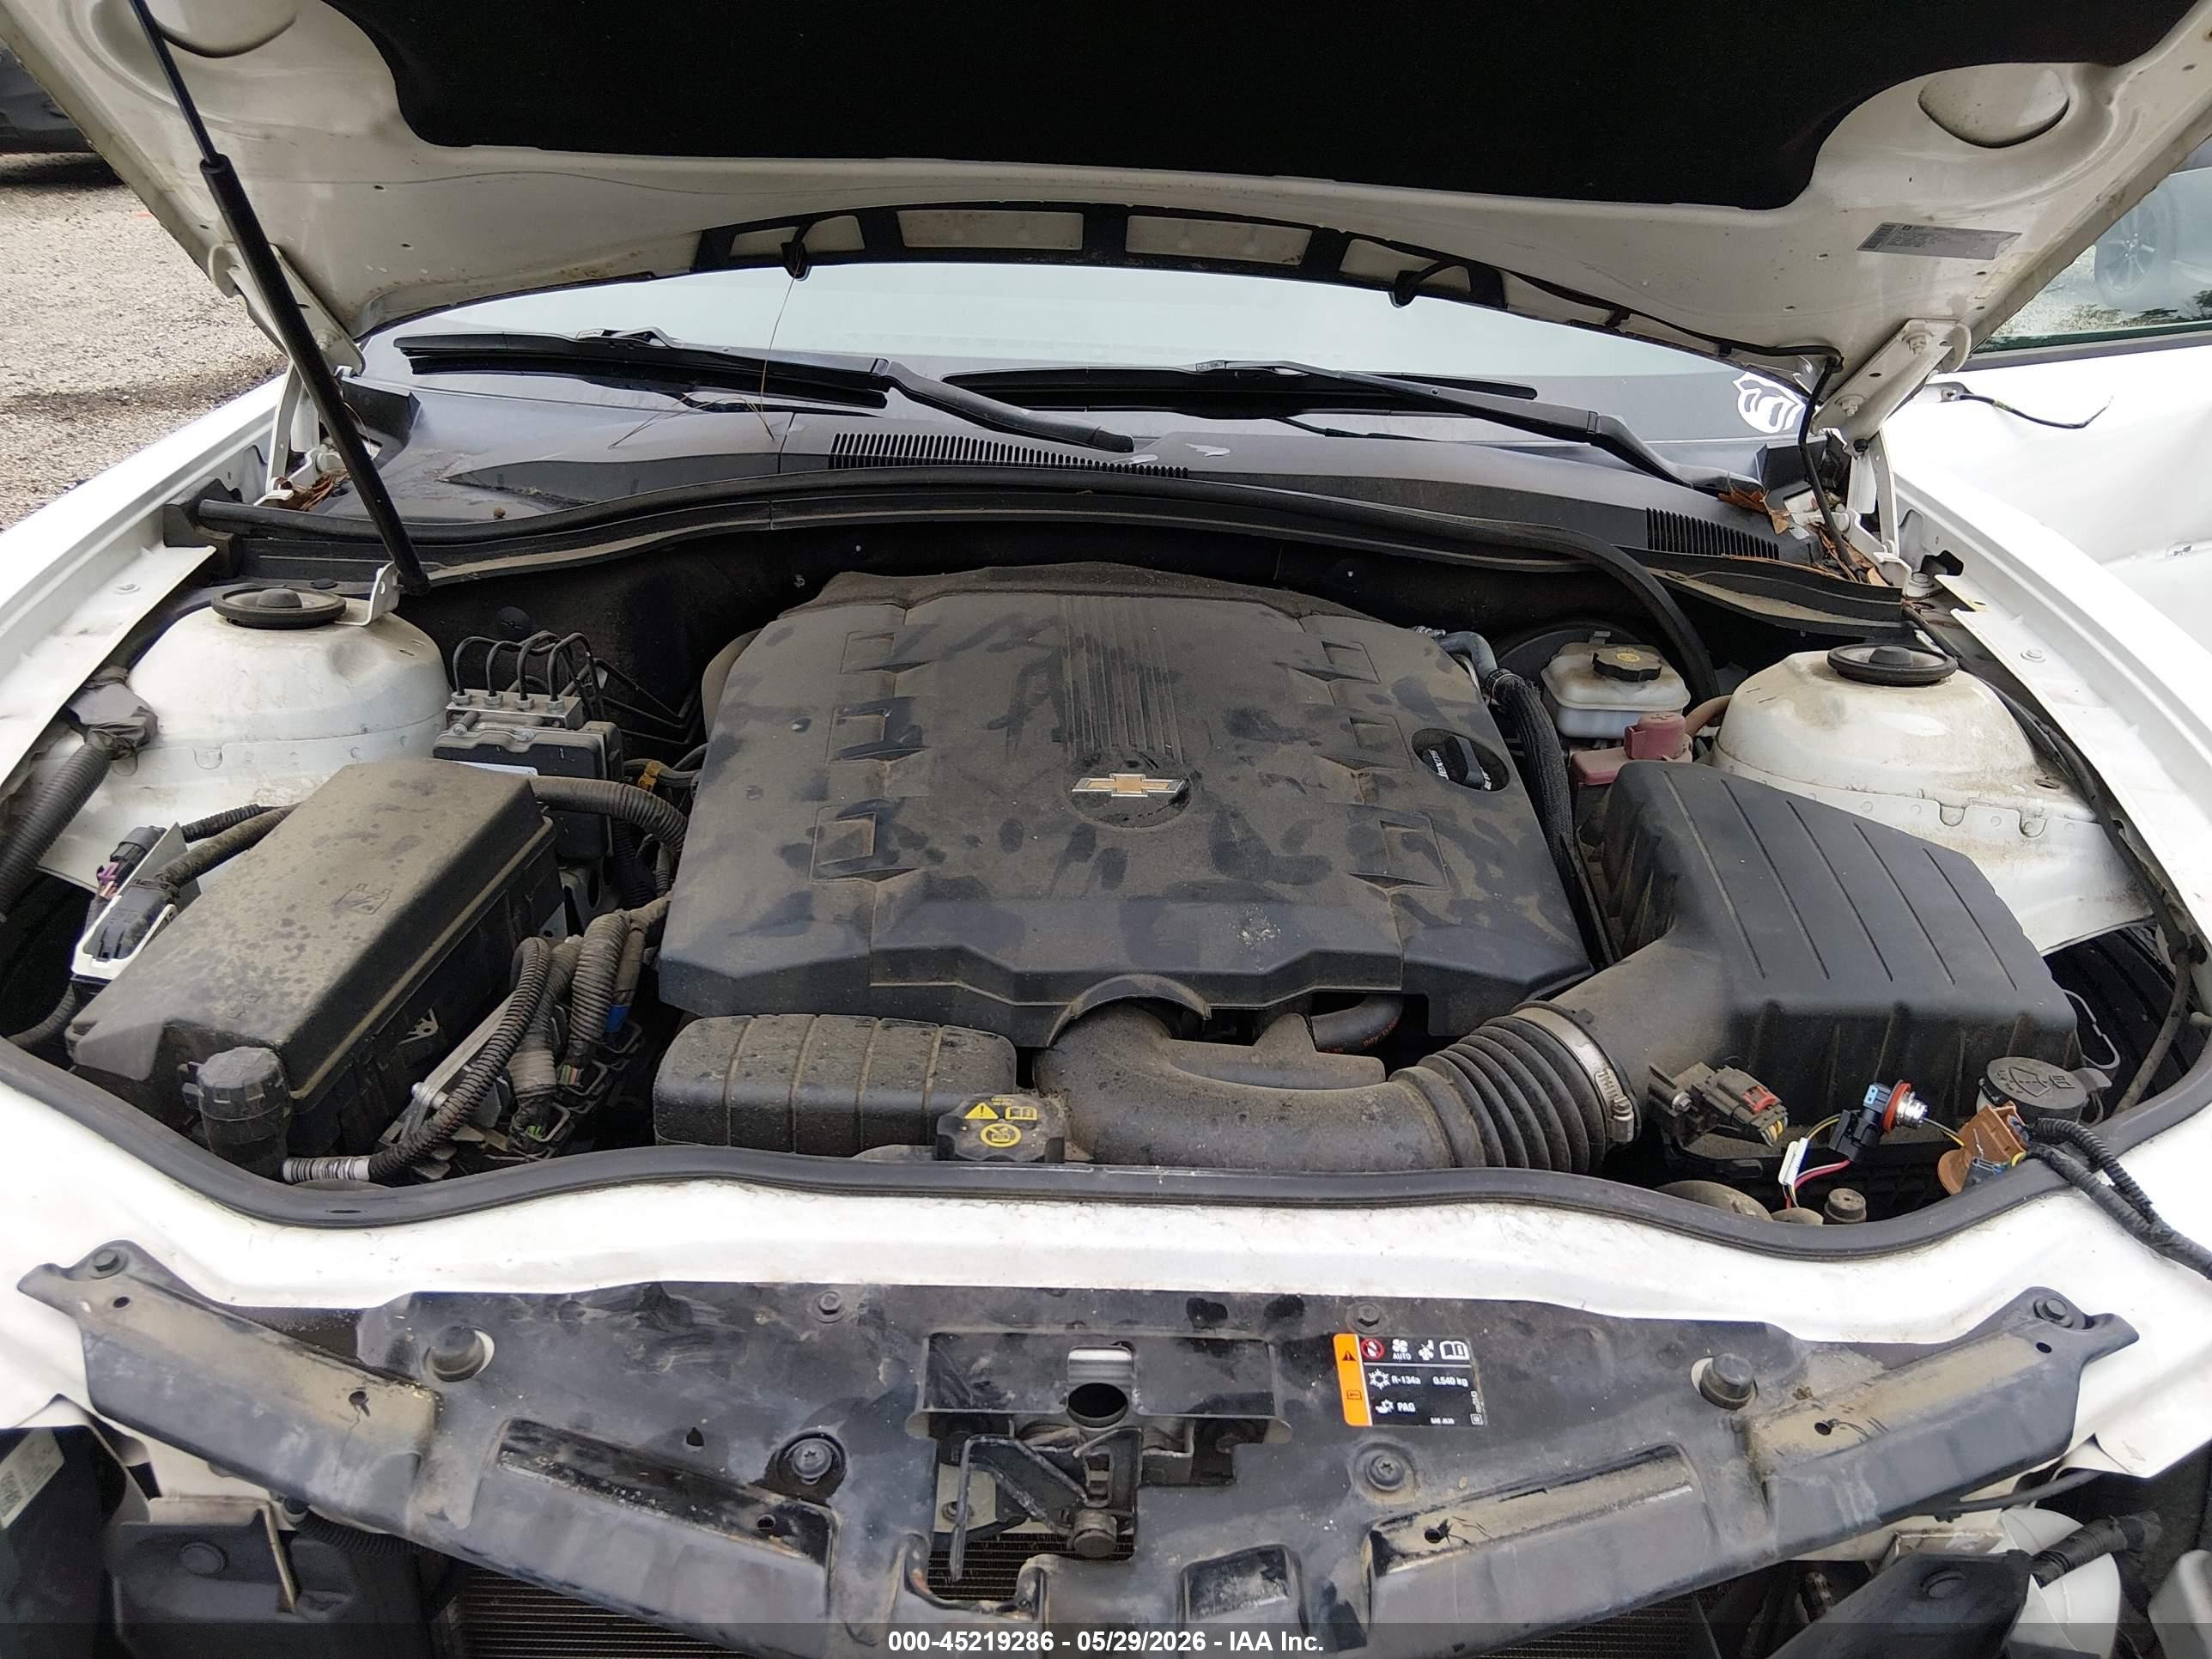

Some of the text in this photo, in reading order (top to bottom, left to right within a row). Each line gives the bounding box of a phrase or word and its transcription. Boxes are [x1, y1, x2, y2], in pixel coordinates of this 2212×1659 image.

[1391, 1375, 1421, 1385] R-134a
[1456, 1377, 1468, 1388] kg
[1397, 1401, 1417, 1413] PAG
